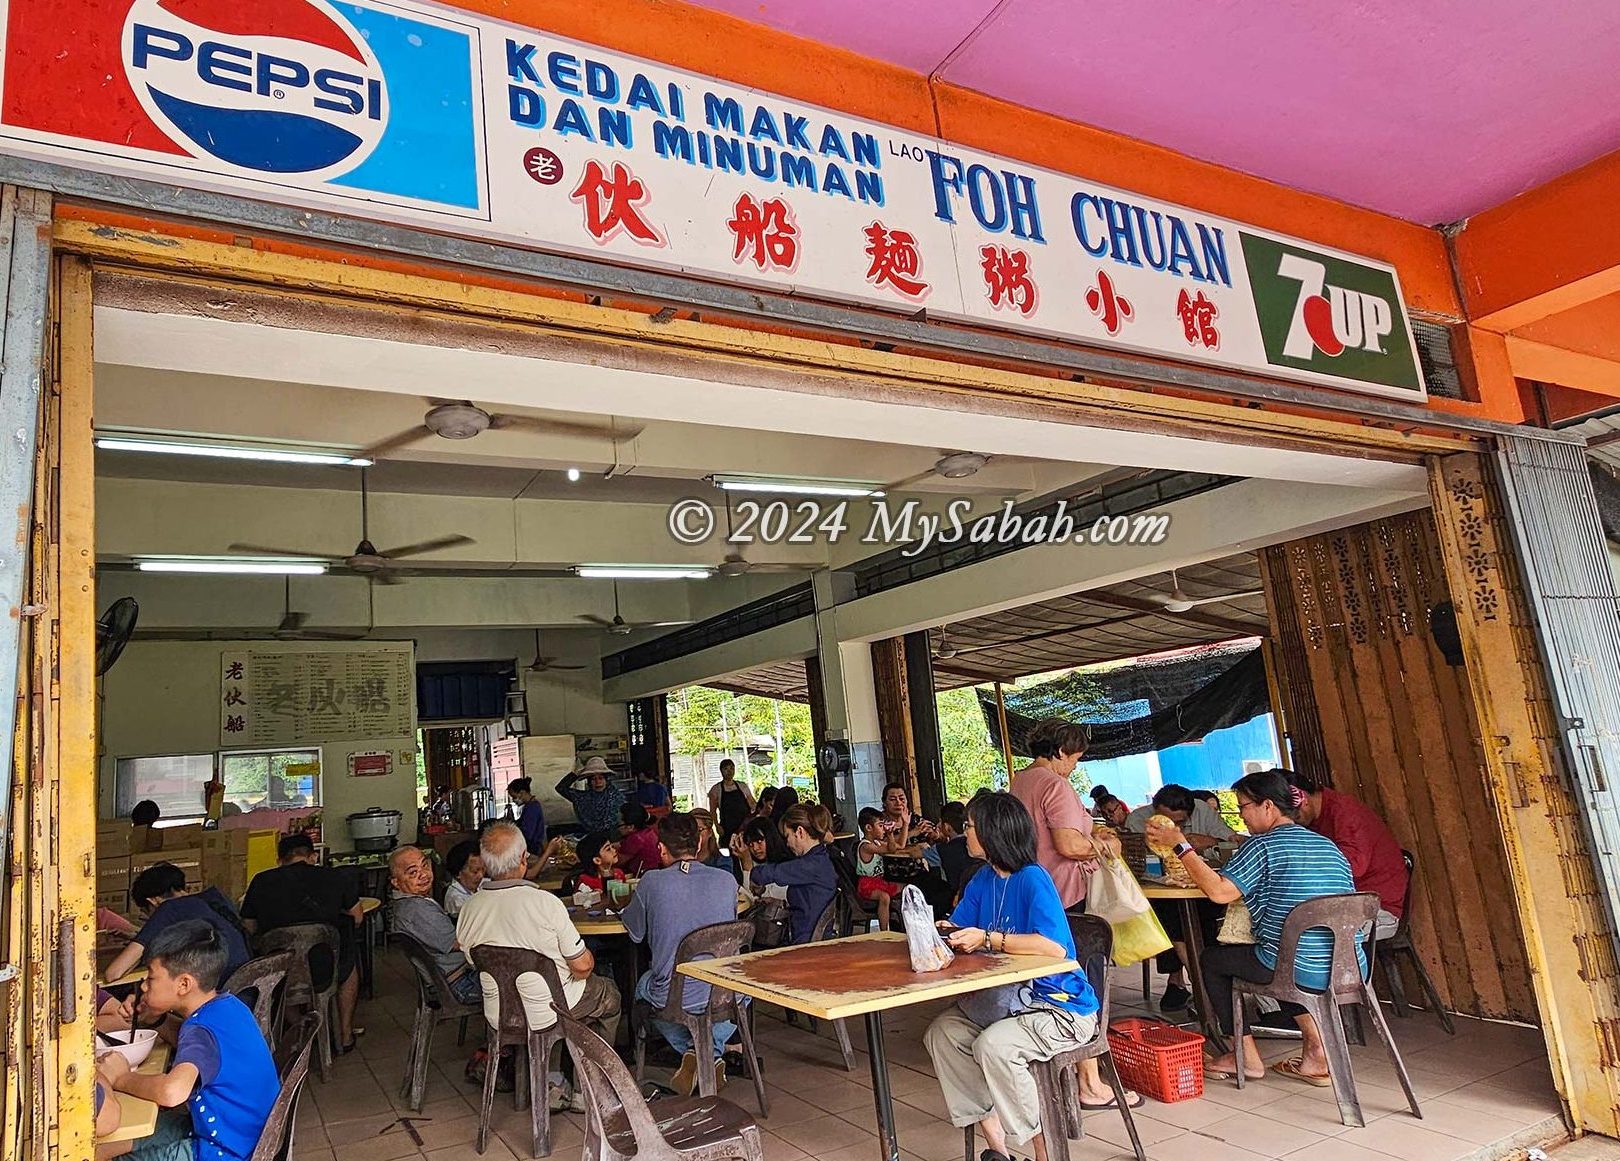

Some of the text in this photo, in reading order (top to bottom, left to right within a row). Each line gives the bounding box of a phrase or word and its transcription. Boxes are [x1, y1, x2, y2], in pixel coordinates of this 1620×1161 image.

[132, 22, 382, 122] PEPSI
[505, 38, 882, 171] KEDAI MAKAN
[508, 83, 886, 208] DAN MINUMAN
[529, 152, 557, 181] 老
[889, 139, 1232, 289] LAO FOH CHUAN
[223, 661, 248, 733] 老伙船
